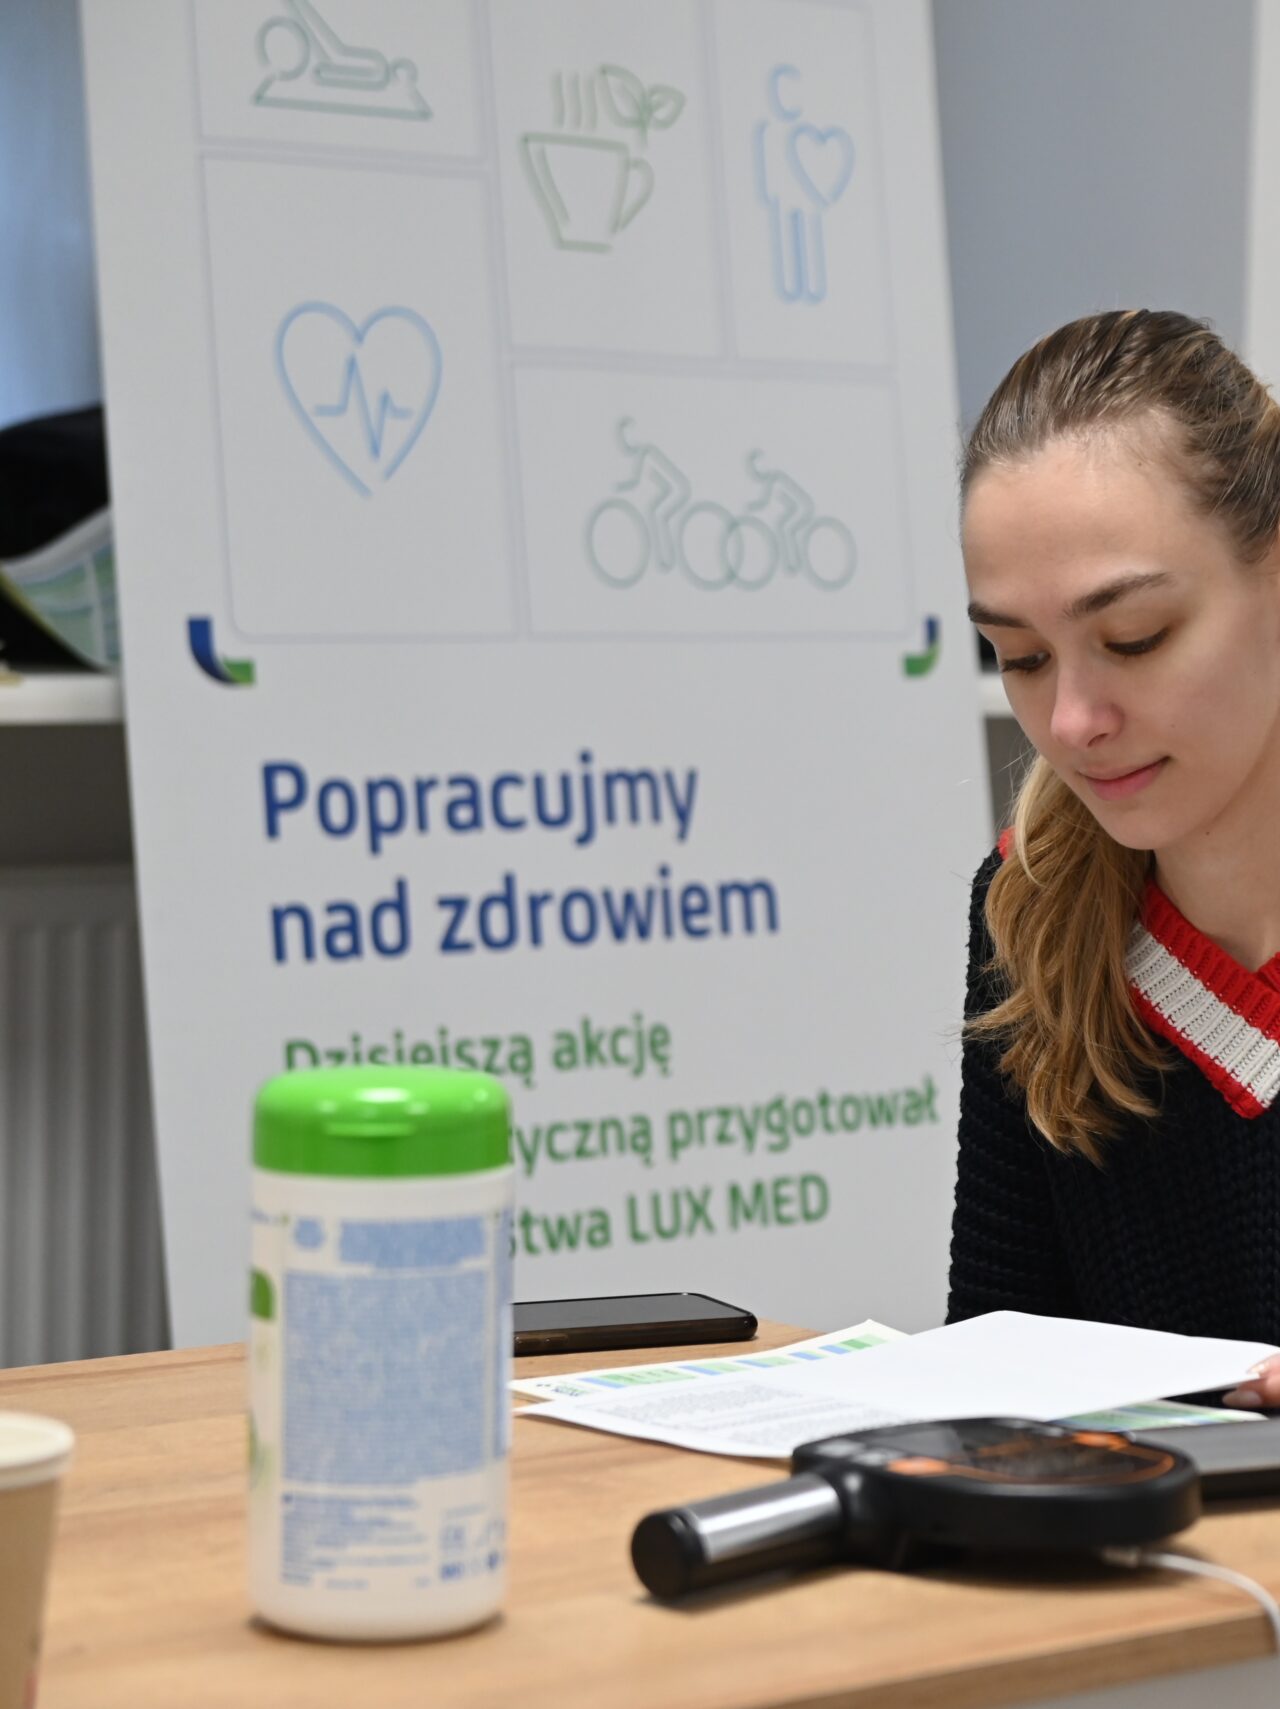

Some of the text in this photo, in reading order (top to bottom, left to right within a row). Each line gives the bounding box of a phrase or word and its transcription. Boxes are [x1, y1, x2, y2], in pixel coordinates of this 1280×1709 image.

[261, 750, 698, 855] Popracujmy
[270, 865, 780, 964] nad zdrowiem
[551, 1012, 671, 1077] akcję
[669, 1075, 939, 1159] przygotował
[626, 1189, 714, 1243] LUX
[728, 1173, 829, 1228] MED
